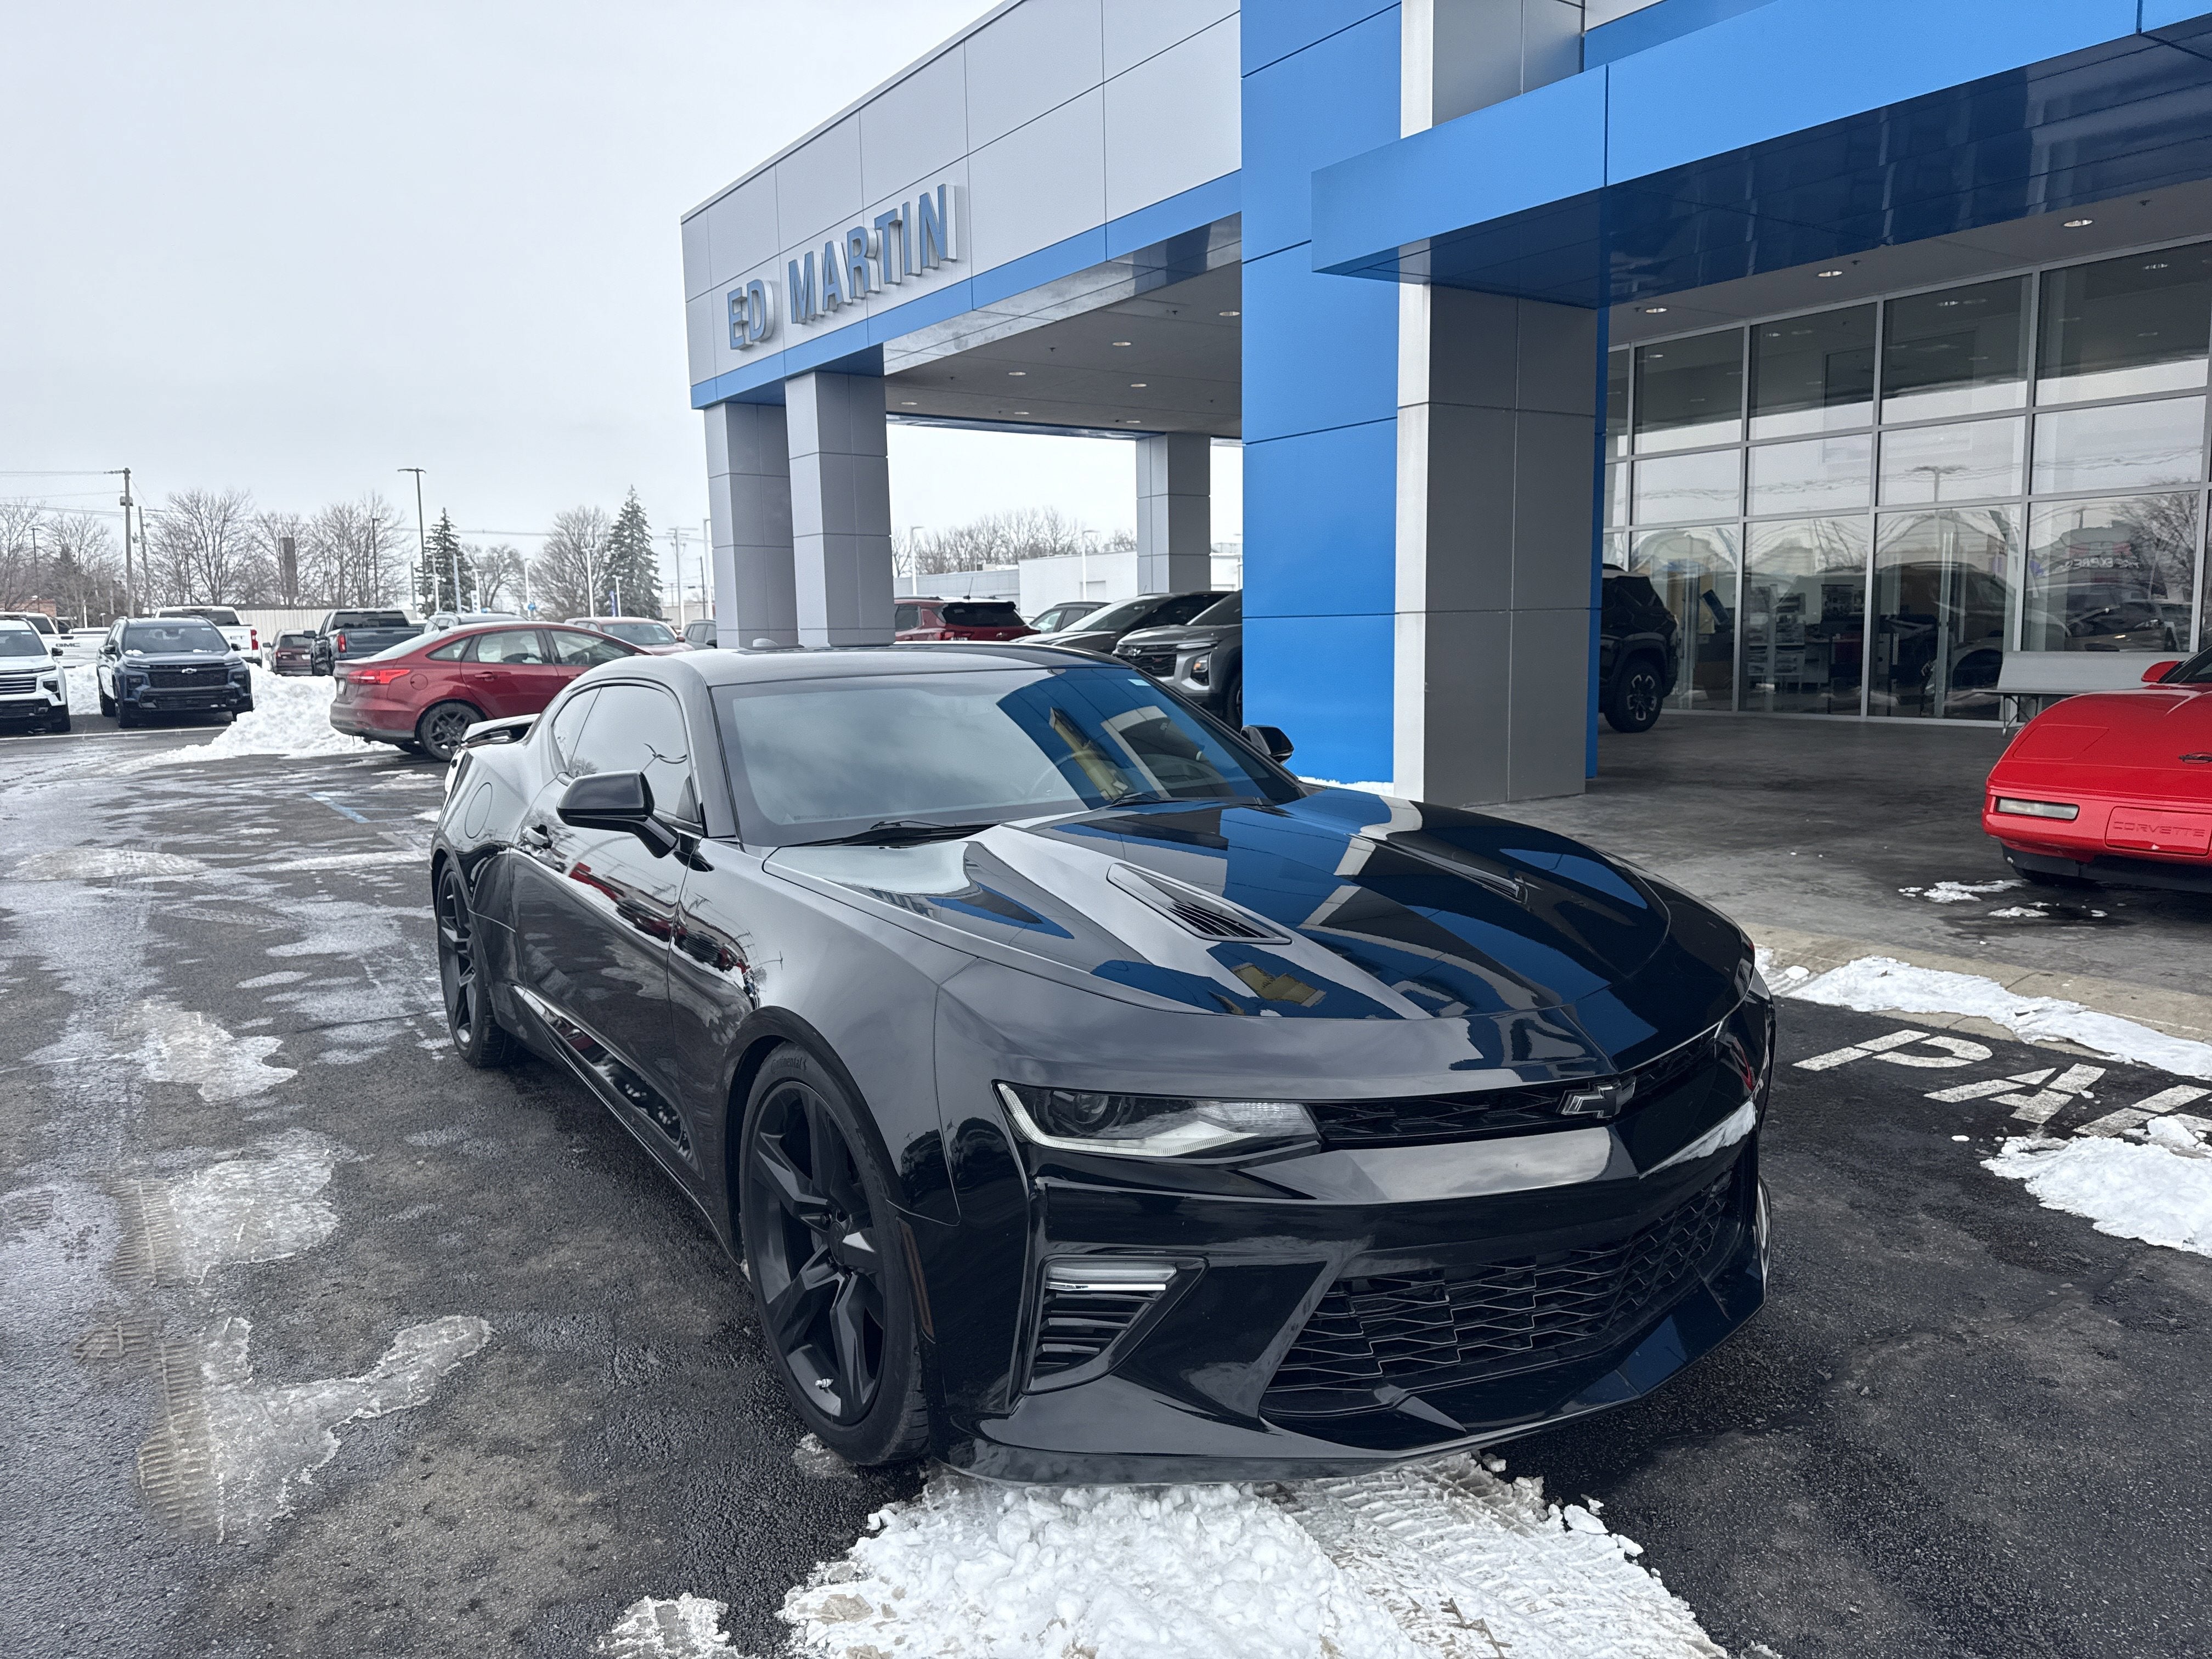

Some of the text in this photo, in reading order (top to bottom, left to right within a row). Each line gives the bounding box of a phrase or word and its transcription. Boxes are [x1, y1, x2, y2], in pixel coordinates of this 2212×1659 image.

[727, 184, 957, 350] ED MARTIN
[2113, 821, 2206, 837] CORVETTE
